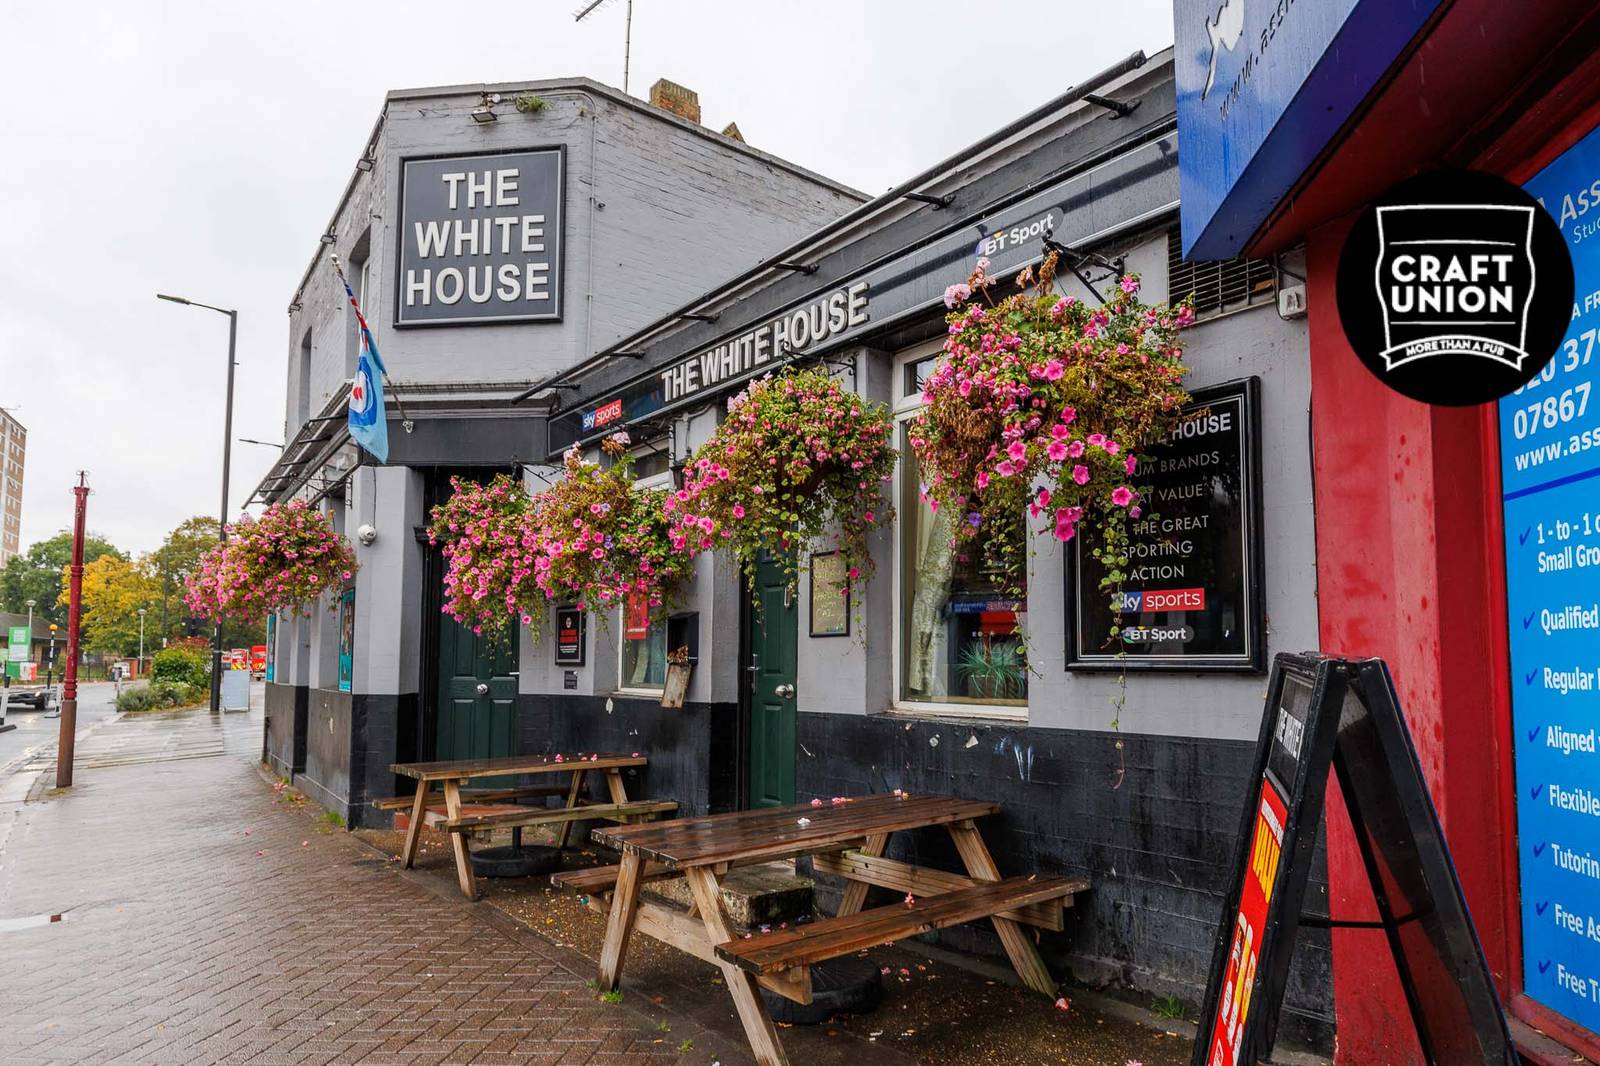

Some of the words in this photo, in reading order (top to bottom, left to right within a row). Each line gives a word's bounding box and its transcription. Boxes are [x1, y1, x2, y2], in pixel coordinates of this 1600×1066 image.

[1220, 0, 1295, 122] www.ass
[442, 168, 519, 209] THE
[415, 215, 545, 258] WHITE
[985, 234, 1008, 256] BT
[1010, 213, 1053, 245] Sport
[406, 263, 549, 306] HOUSE
[661, 358, 700, 402] THE
[700, 326, 771, 387] WHITE
[774, 281, 869, 357] HOUSE
[1563, 328, 1600, 373] 37
[583, 412, 596, 429] sky
[597, 403, 620, 424] sports
[1513, 381, 1591, 440] 07867
[1172, 412, 1231, 441] HOUSE
[1160, 451, 1220, 473] BRANDS
[1159, 483, 1203, 501] VALUE
[1162, 515, 1209, 533] GREAT
[1121, 540, 1193, 559] SPORTING
[1538, 545, 1572, 573] Small
[1130, 564, 1184, 581] ACTION
[1119, 594, 1141, 611] ky
[1146, 592, 1201, 610] sports
[1131, 629, 1149, 640] BT
[1151, 627, 1186, 642] Sport
[1541, 603, 1599, 636] Qualified
[1544, 667, 1594, 695] Regular
[1547, 725, 1595, 754] Aligned
[1549, 784, 1600, 816] Flexible
[1555, 903, 1584, 935] Free
[1557, 963, 1587, 998] Free
